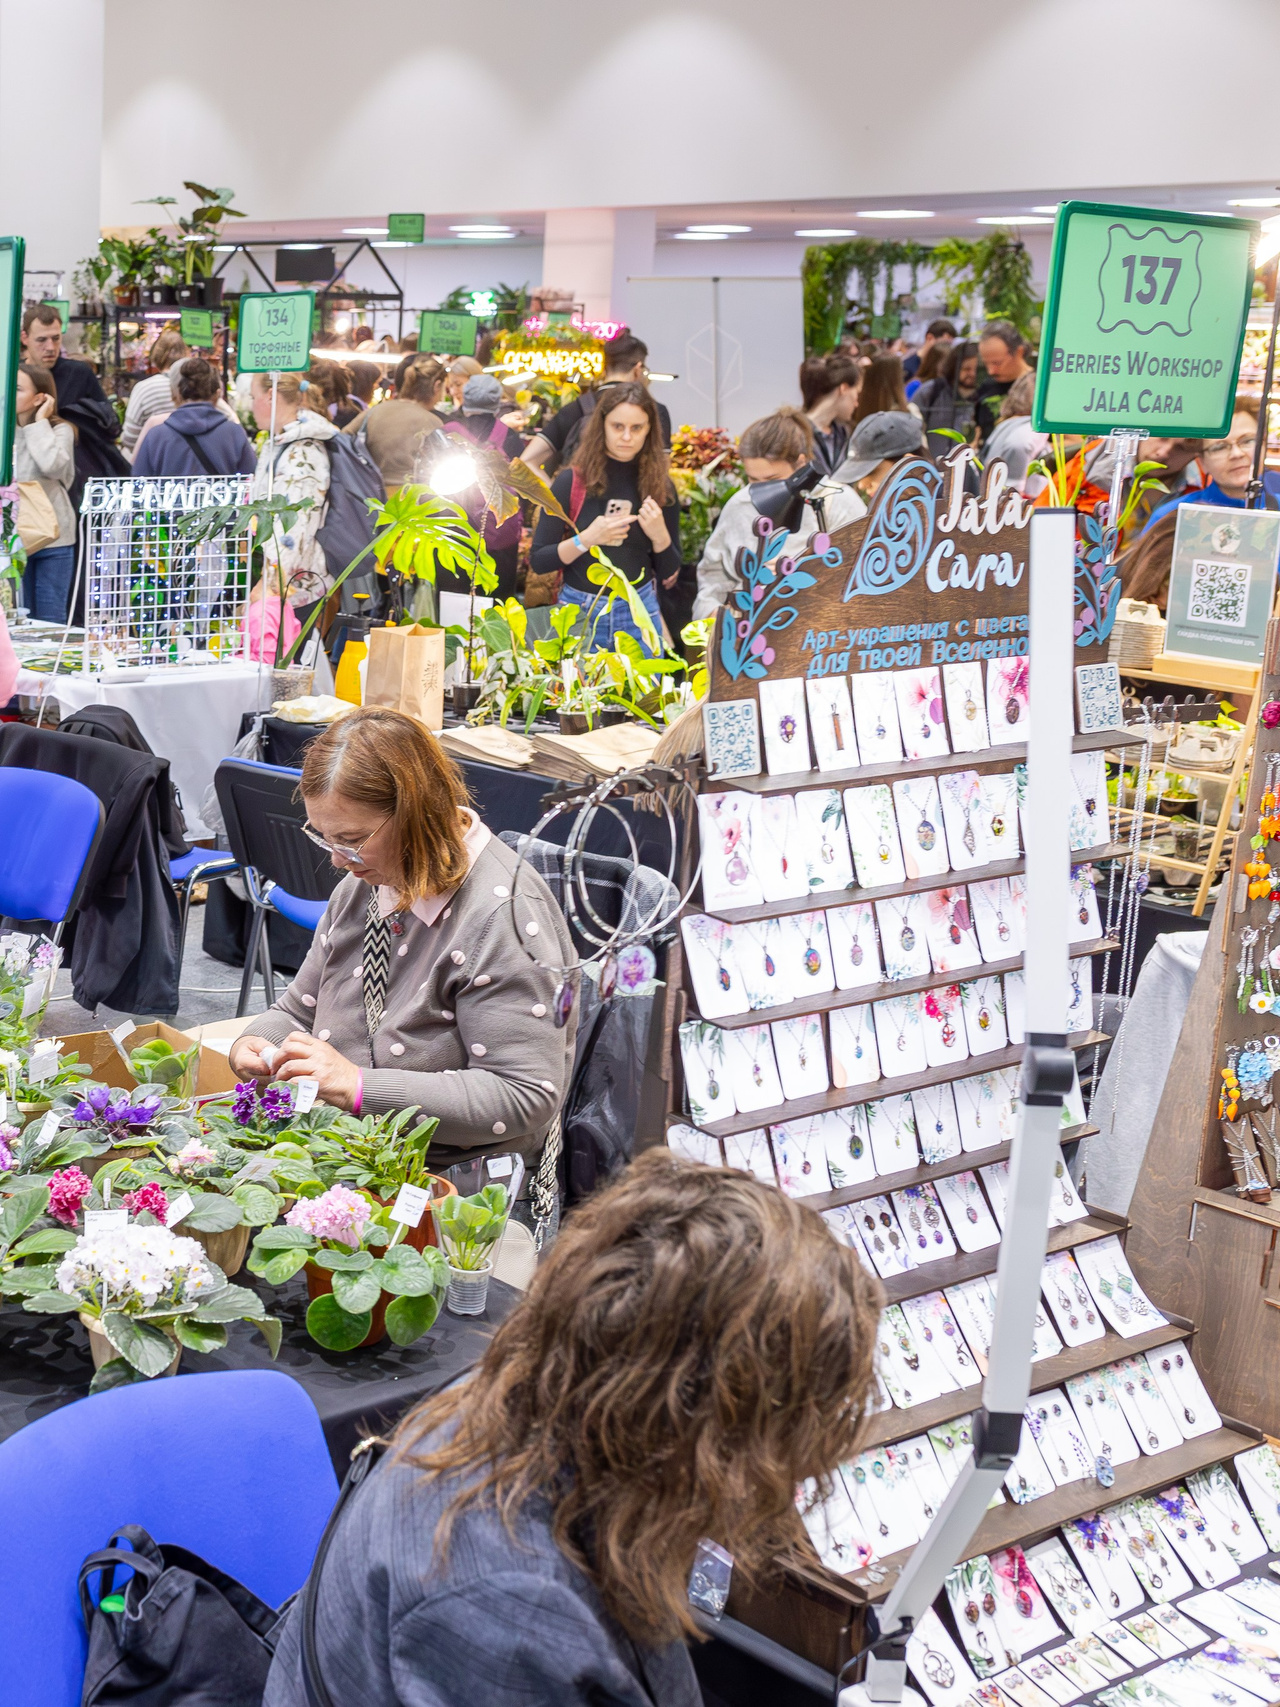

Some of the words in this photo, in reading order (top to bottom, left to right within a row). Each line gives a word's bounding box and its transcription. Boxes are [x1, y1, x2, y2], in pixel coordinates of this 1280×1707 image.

[1122, 254, 1182, 305] 137
[266, 308, 289, 326] 134
[249, 341, 301, 354] ТОРФЯНЫЕ
[255, 355, 292, 367] БОЛОТА
[937, 447, 1034, 535] Jala
[925, 539, 1024, 593] Cara
[802, 621, 950, 654] Арт-украшения
[956, 621, 969, 637] с
[975, 614, 1029, 638] цвета
[858, 642, 922, 671] твоей
[932, 636, 1029, 665] Вселенно
